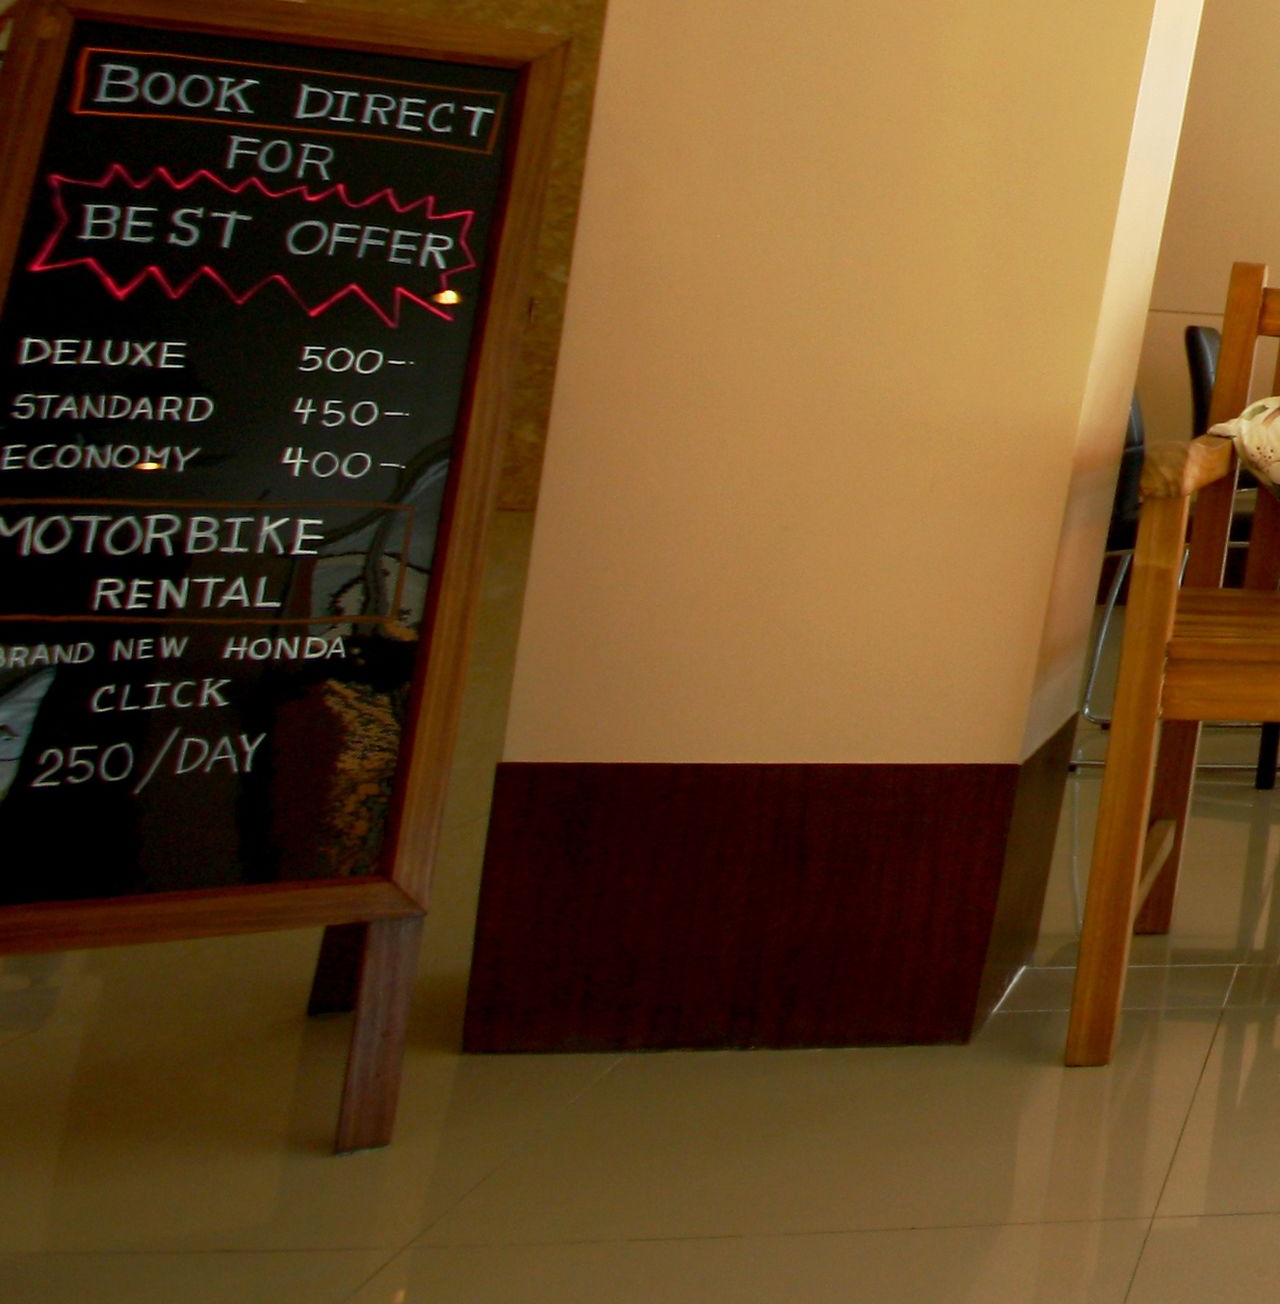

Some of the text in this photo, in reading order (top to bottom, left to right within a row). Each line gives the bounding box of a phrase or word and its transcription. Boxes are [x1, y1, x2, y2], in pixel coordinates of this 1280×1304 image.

[94, 63, 495, 137] BOOK DIRECT
[225, 135, 336, 181] FOR
[78, 204, 454, 270] BEST OFFER
[18, 337, 187, 369] DELUXE
[10, 394, 214, 423] STANDARD
[1, 444, 200, 473] ECONOMY
[0, 513, 324, 557] MOTORBIKE
[93, 577, 281, 611] RENTAL
[112, 636, 189, 661] NEW
[223, 636, 347, 661] HONDA
[91, 678, 231, 713] CLICK
